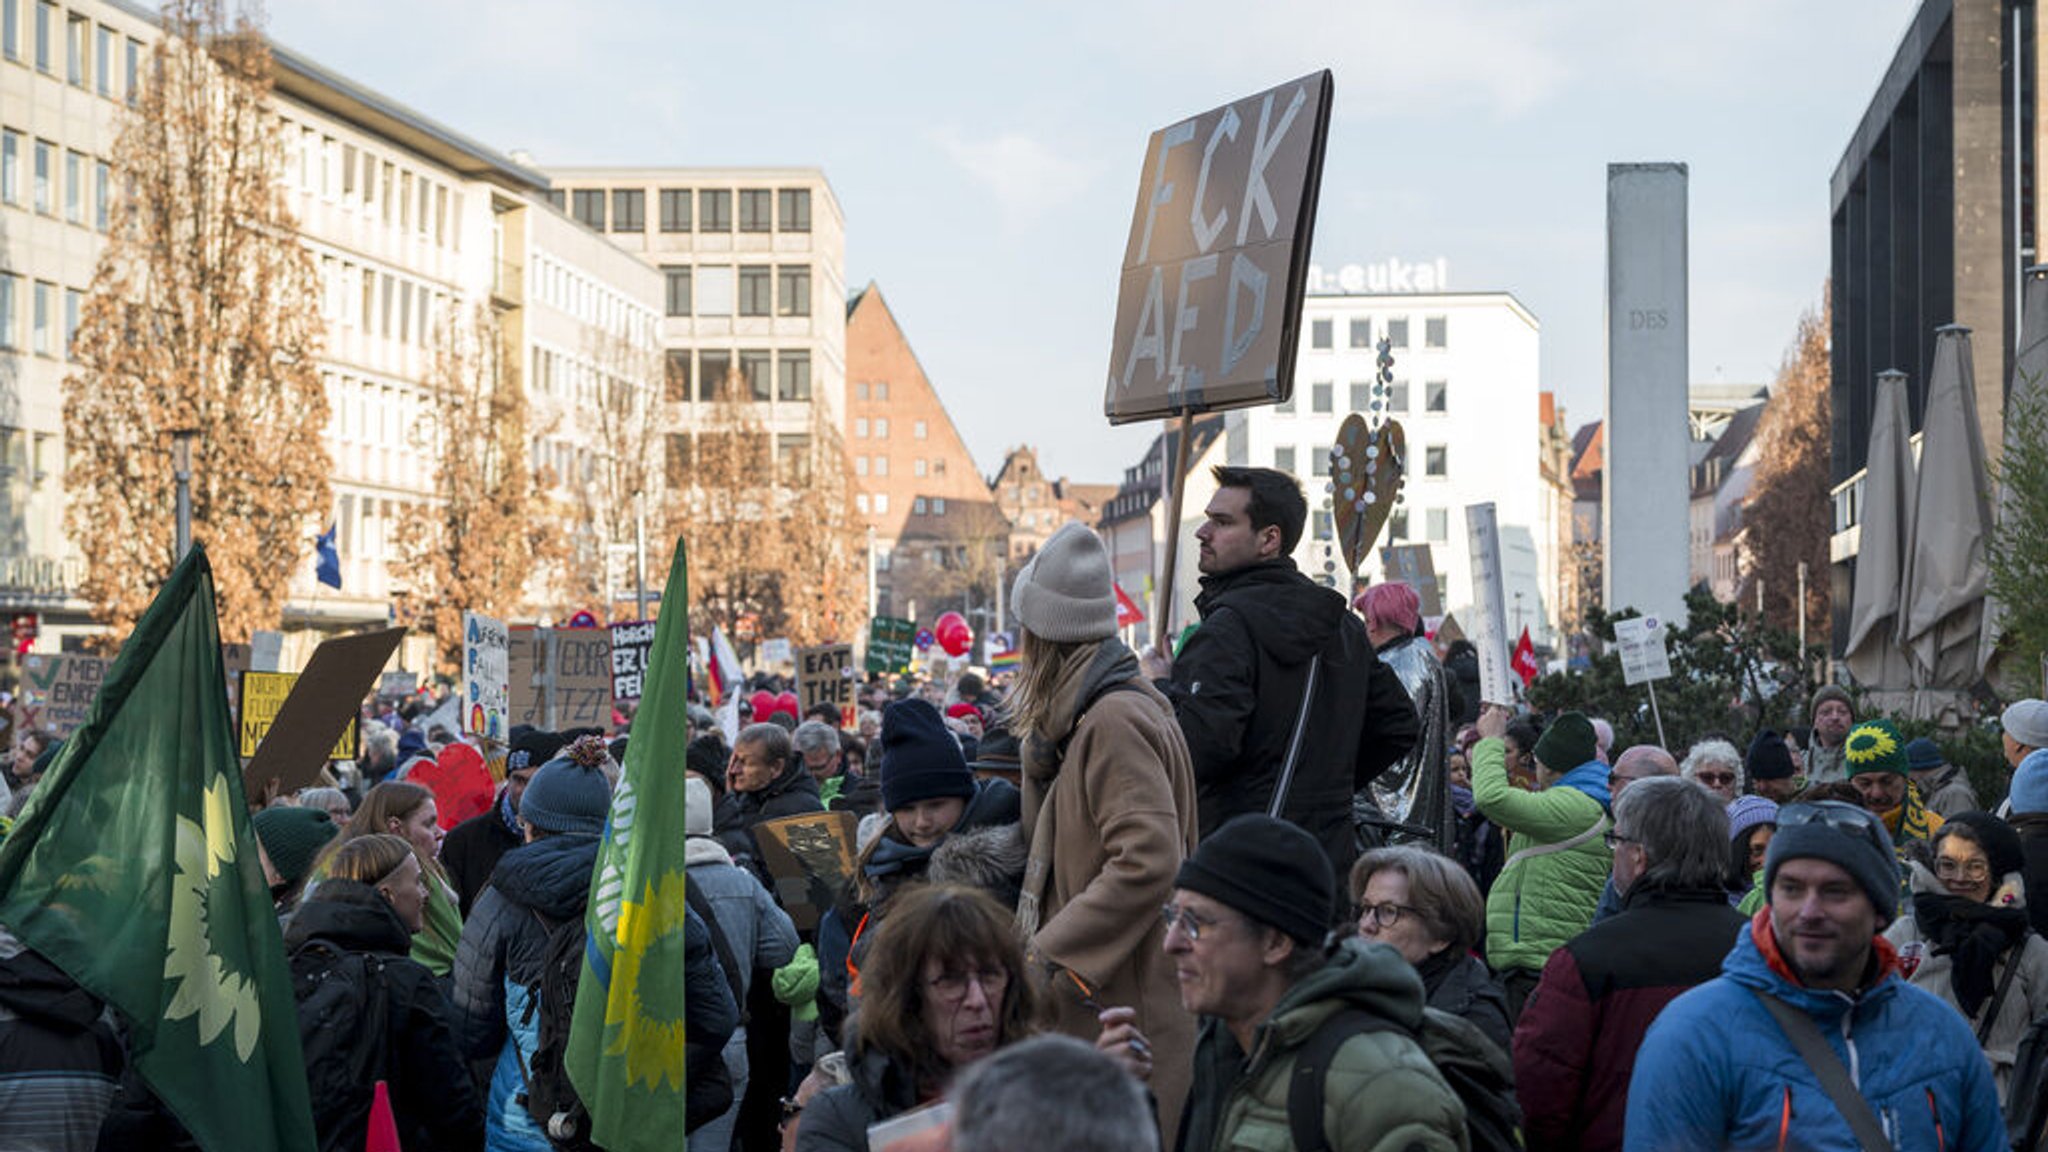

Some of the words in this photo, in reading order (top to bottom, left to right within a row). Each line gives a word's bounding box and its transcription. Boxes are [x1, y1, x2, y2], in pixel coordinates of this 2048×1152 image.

[1138, 85, 1307, 265] FCK
[1629, 309, 1669, 331] DES
[804, 650, 849, 674] EAT
[523, 685, 609, 723] JTZT
[805, 679, 851, 706] THE
